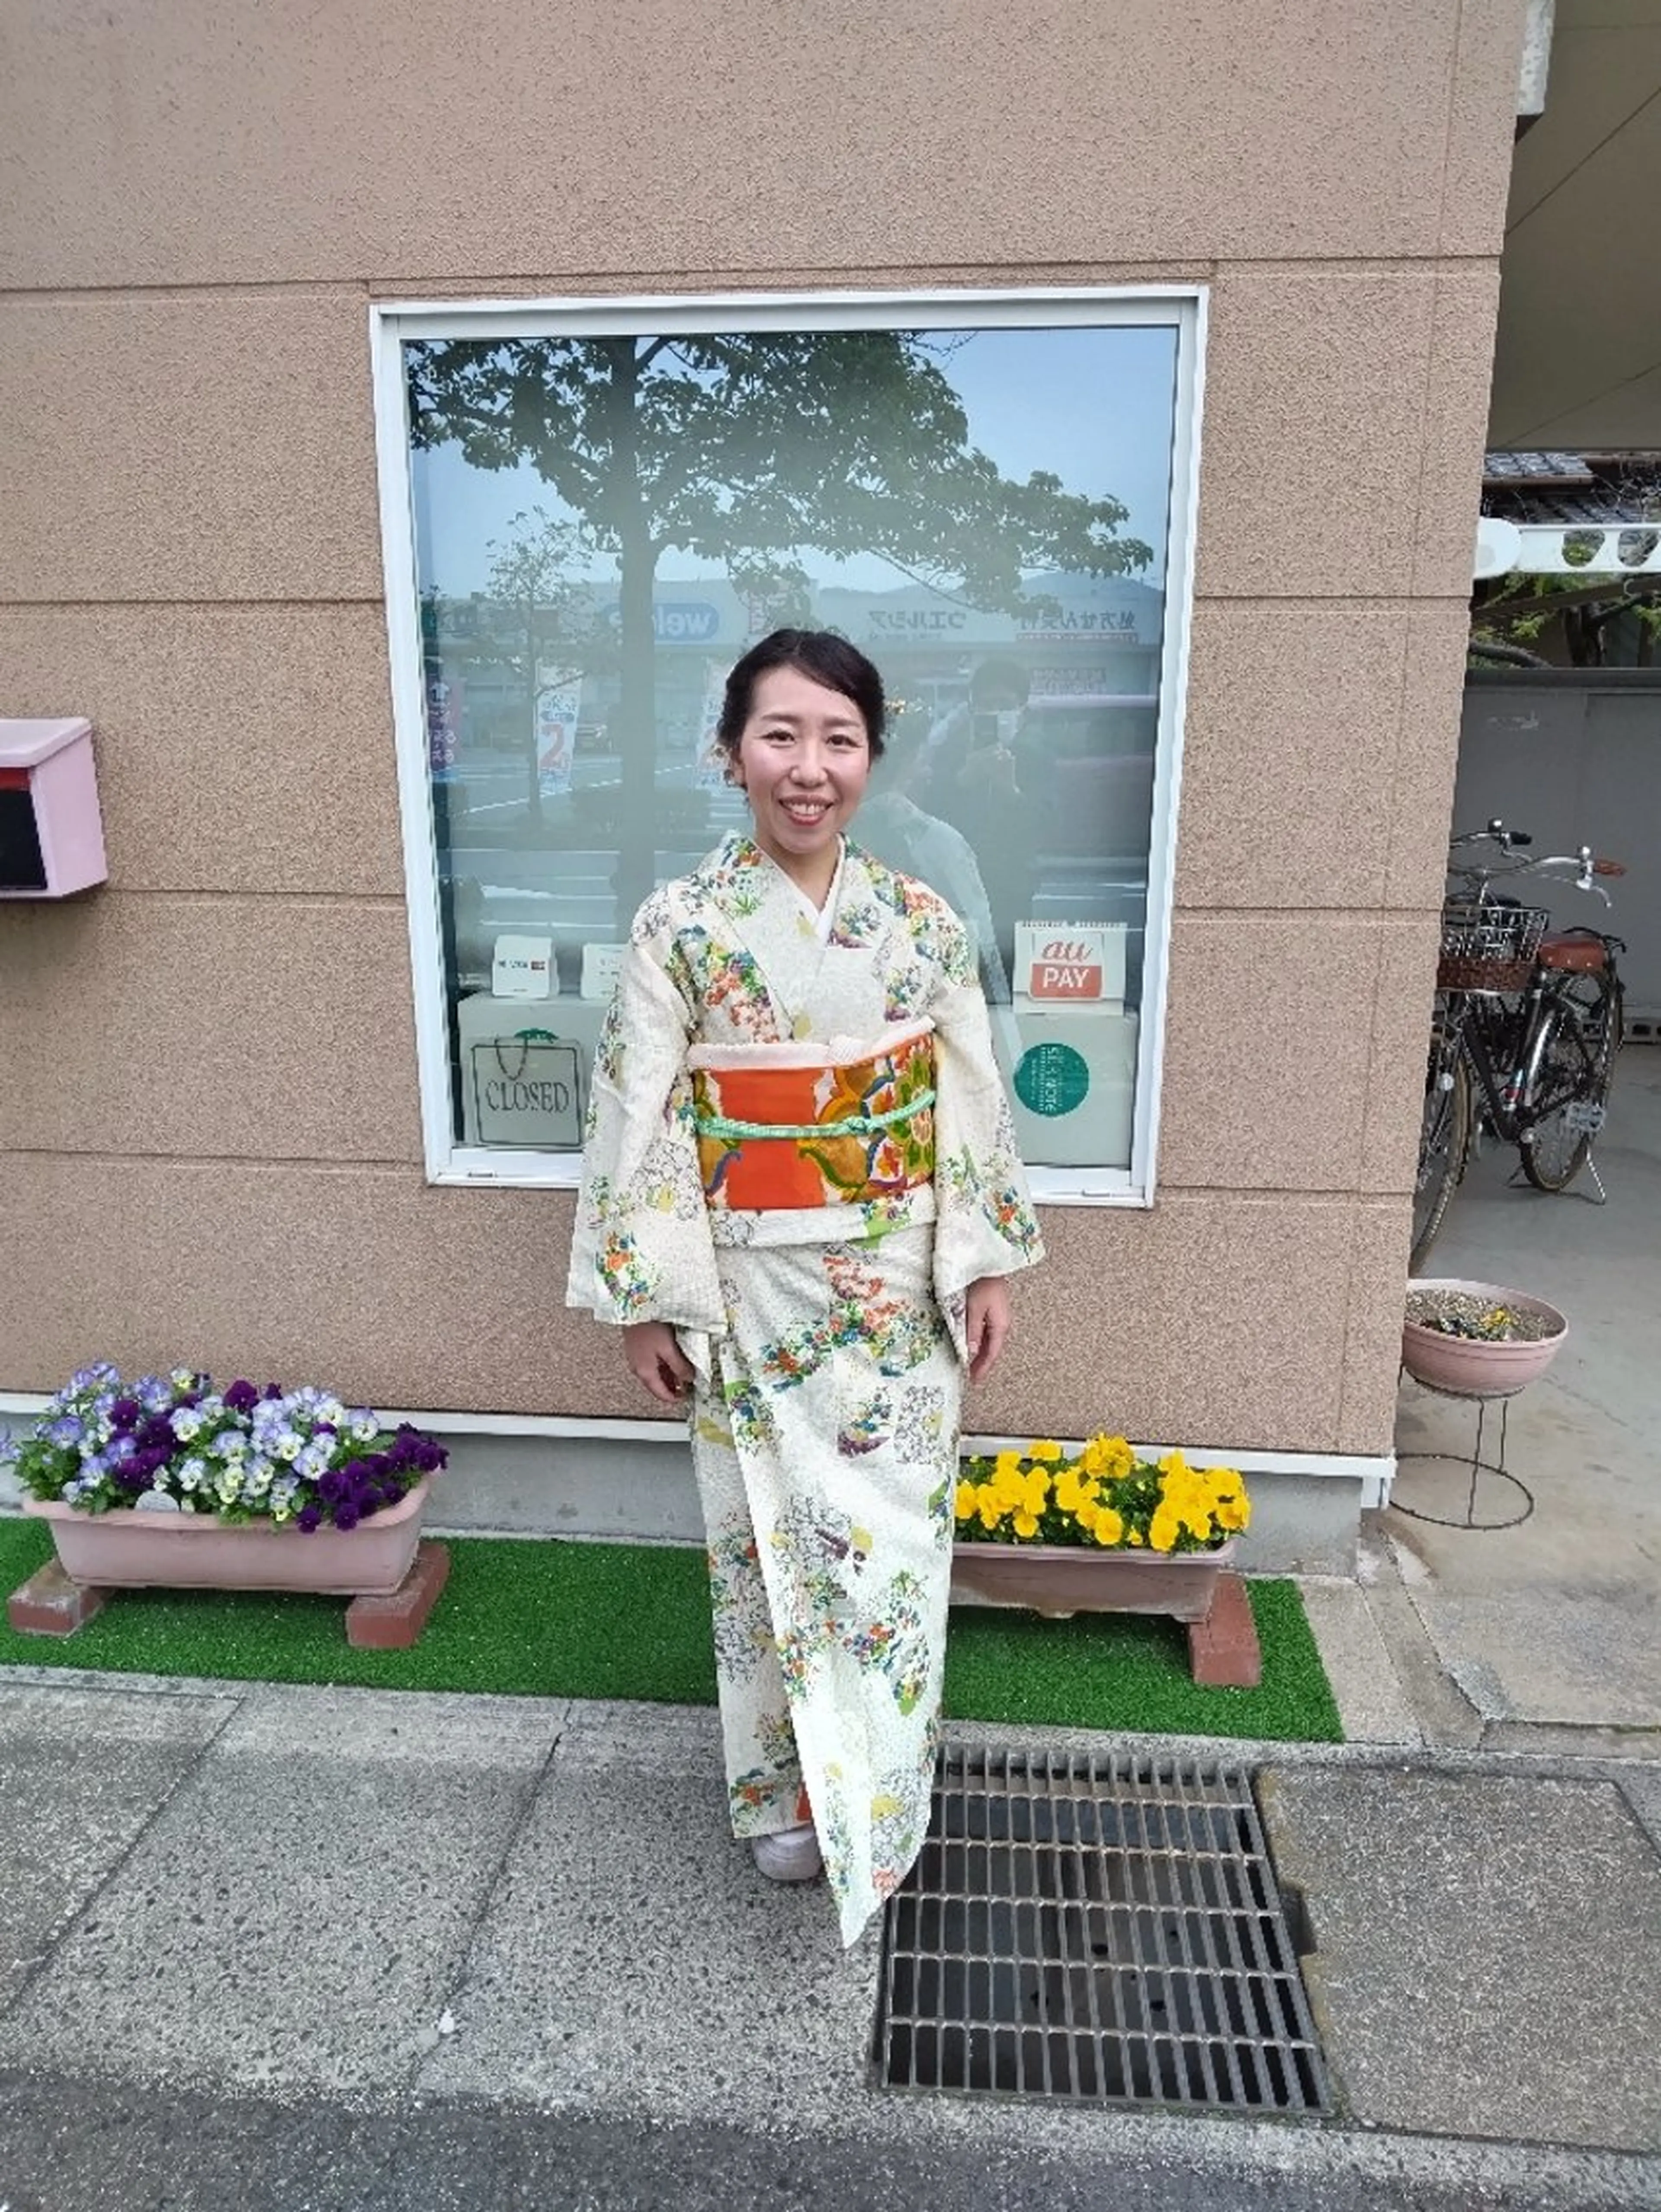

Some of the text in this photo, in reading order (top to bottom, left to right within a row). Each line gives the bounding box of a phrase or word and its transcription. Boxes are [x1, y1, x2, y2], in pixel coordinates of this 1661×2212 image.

[1042, 940, 1093, 962] au
[1043, 967, 1089, 988] PAY
[485, 1080, 569, 1113] CLOSED
